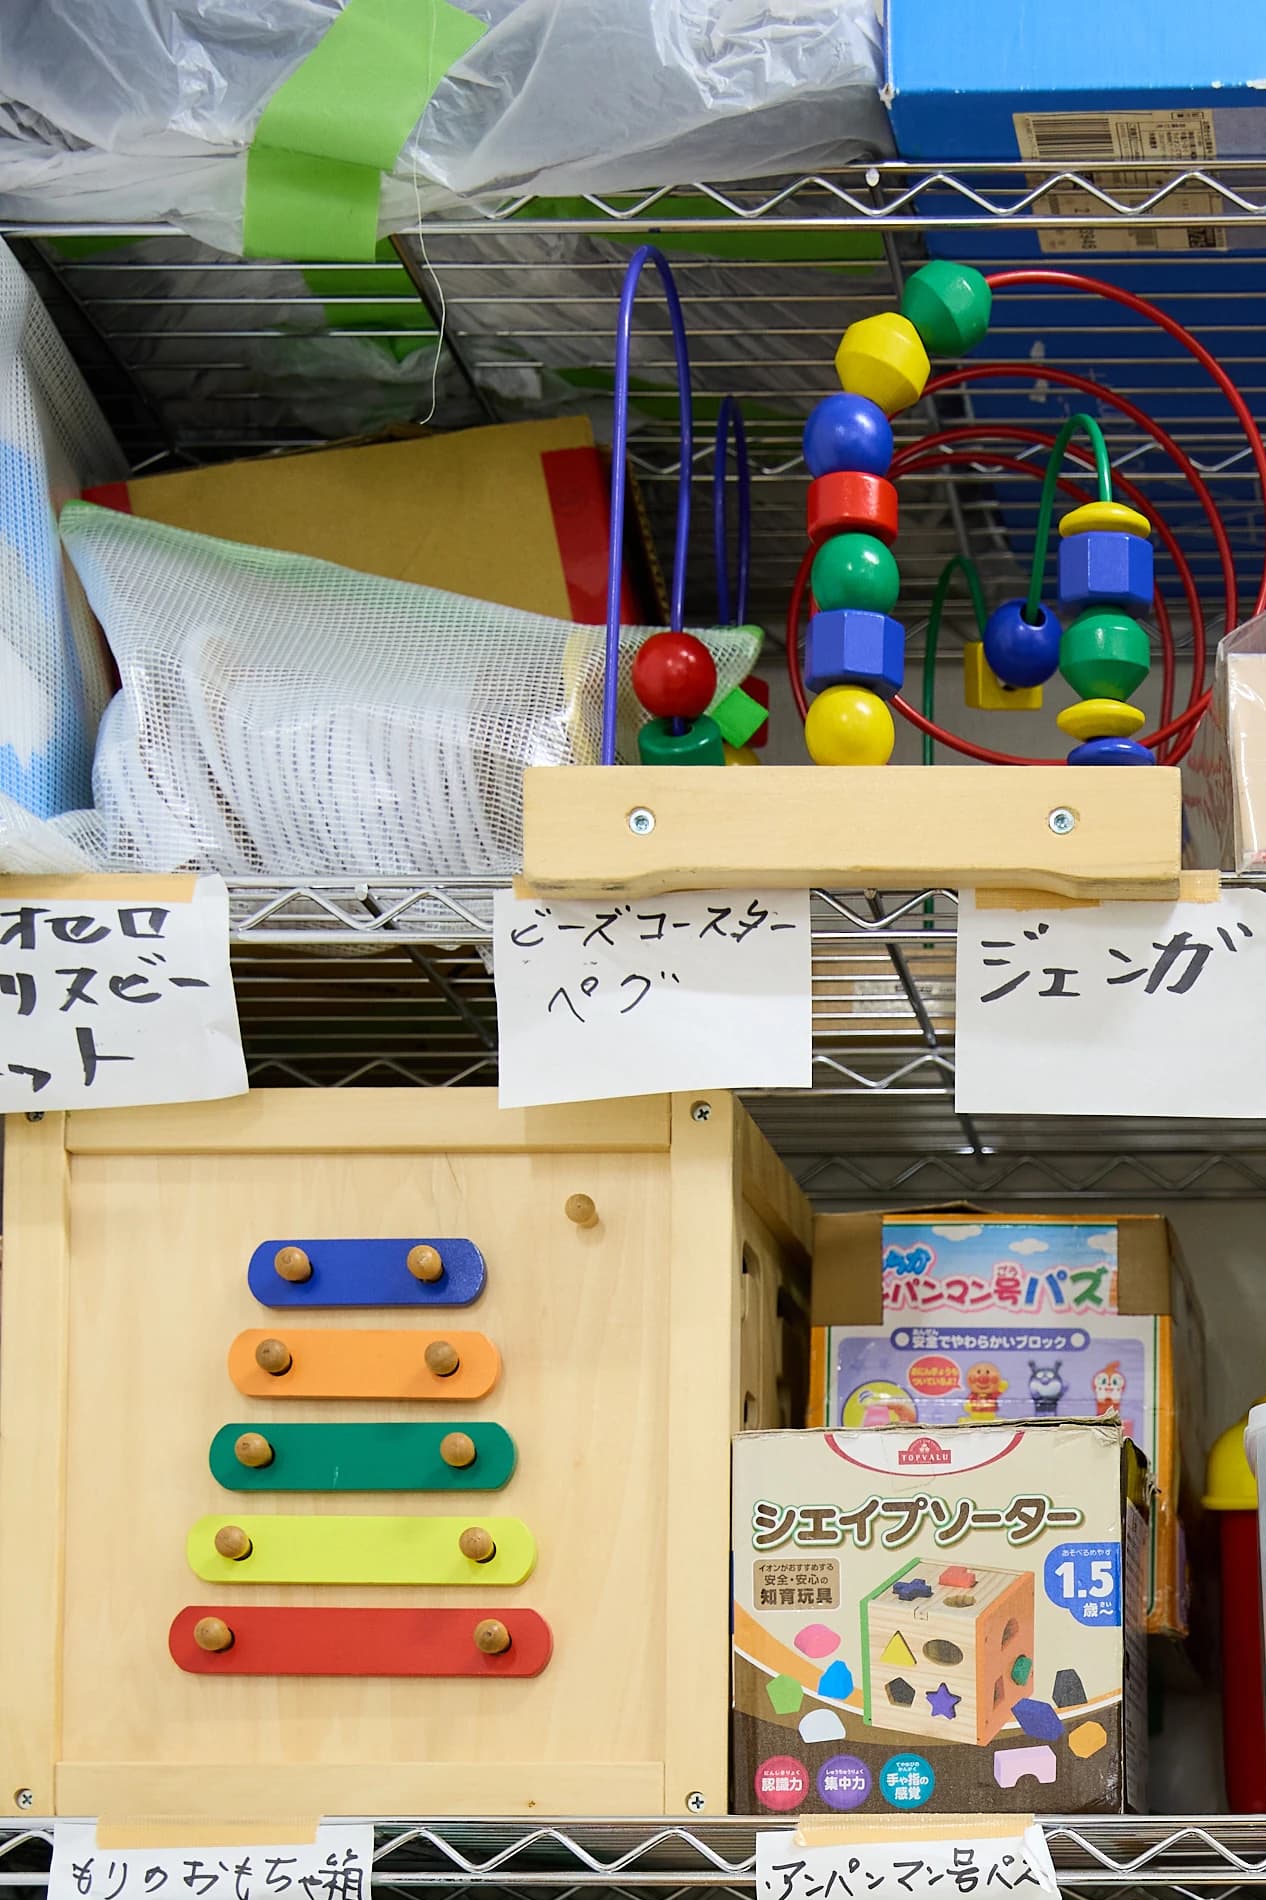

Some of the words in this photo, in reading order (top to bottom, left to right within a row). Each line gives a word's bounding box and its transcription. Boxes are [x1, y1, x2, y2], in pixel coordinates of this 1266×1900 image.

[511, 898, 797, 948] ビーズコースター
[980, 921, 1254, 1004] ジェンガ
[547, 972, 682, 1023] ペグ
[883, 1266, 1117, 1307] パンマン号パズ
[911, 1334, 1067, 1350] 安全でやわらかいブロック
[901, 1453, 949, 1462] TOPVALU
[754, 1496, 1078, 1545] シェイプソーター
[1062, 1549, 1112, 1557] あそべるめやす
[759, 1564, 834, 1572] イオンがおすすめする
[765, 1574, 828, 1585] 安全・安心の
[1054, 1561, 1114, 1600] 1.5
[760, 1588, 832, 1605] 知育玩具
[762, 1778, 802, 1791] 認識力
[824, 1777, 865, 1790] 集中力
[886, 1773, 928, 1786] 手や指の
[895, 1787, 921, 1800] 感覚
